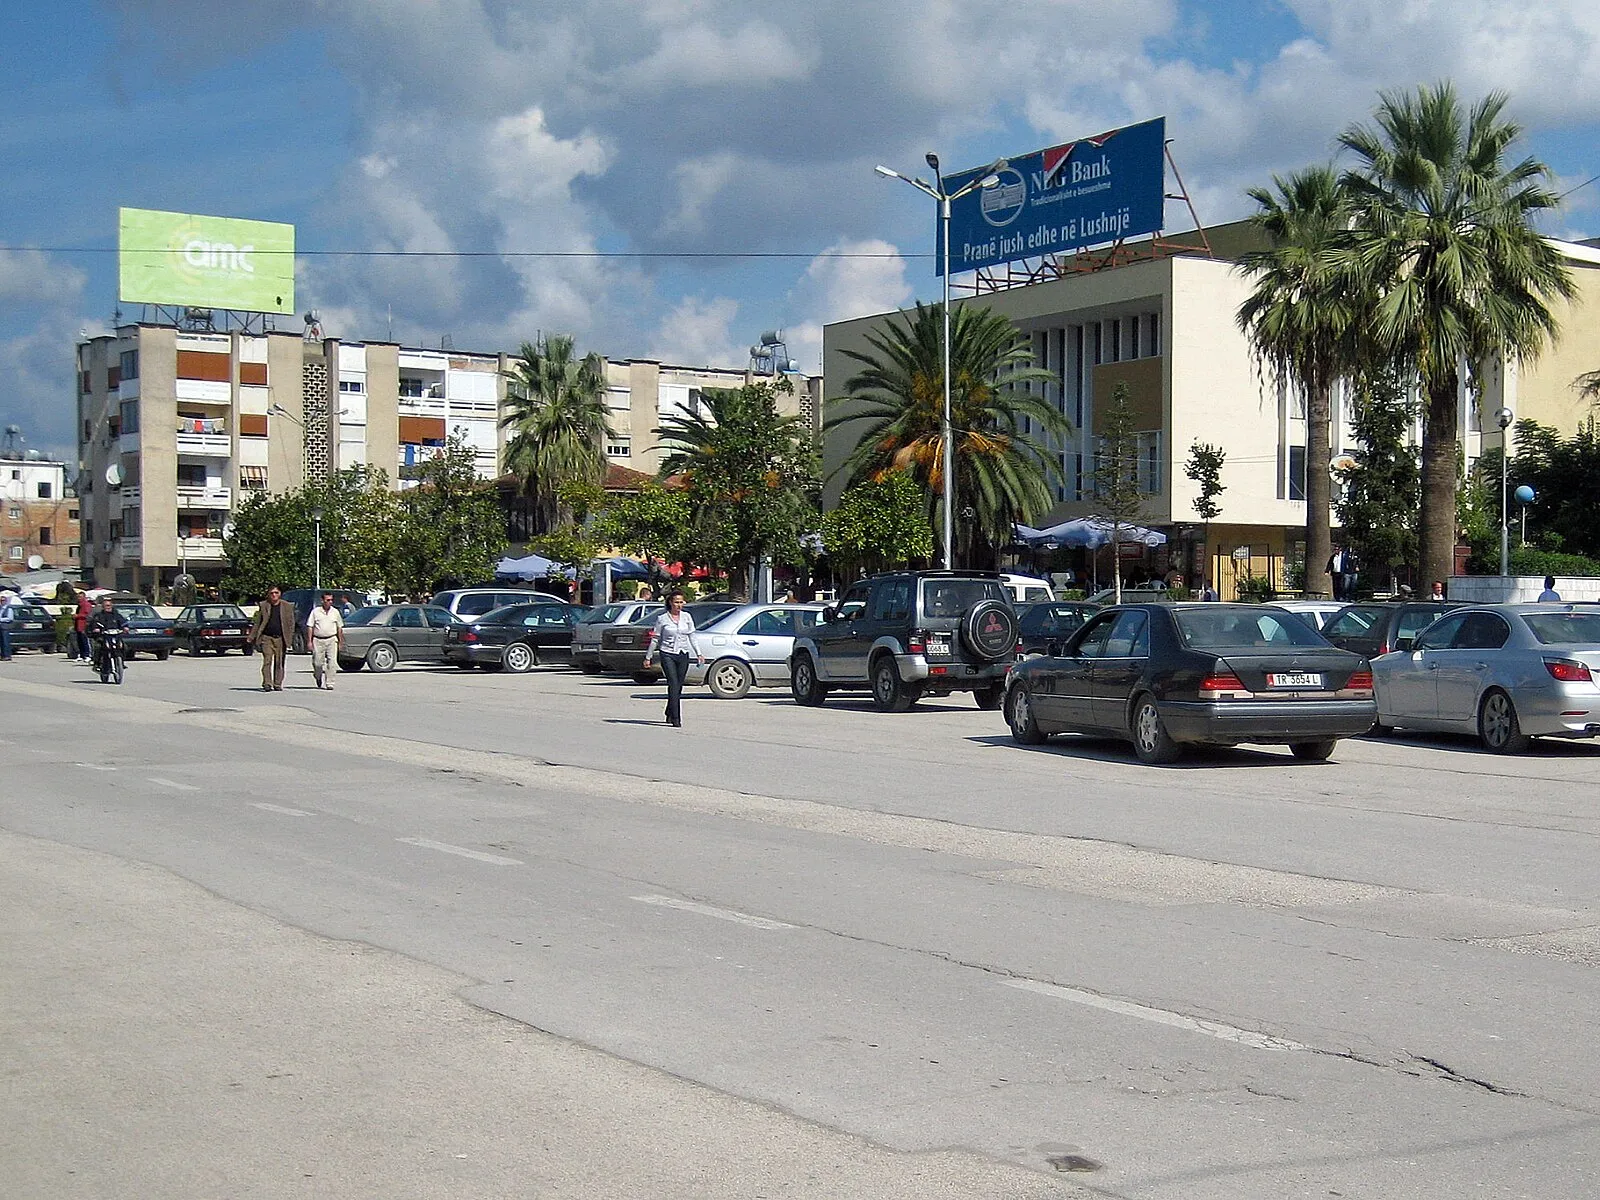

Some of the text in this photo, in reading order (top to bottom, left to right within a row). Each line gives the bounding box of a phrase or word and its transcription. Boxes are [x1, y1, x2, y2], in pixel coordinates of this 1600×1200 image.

[1071, 154, 1111, 184] Bank
[963, 207, 1130, 262] Pranë jush edhe në Lushnjë
[184, 240, 254, 273] amc
[1276, 675, 1287, 684] TR
[1291, 675, 1310, 684] 3654
